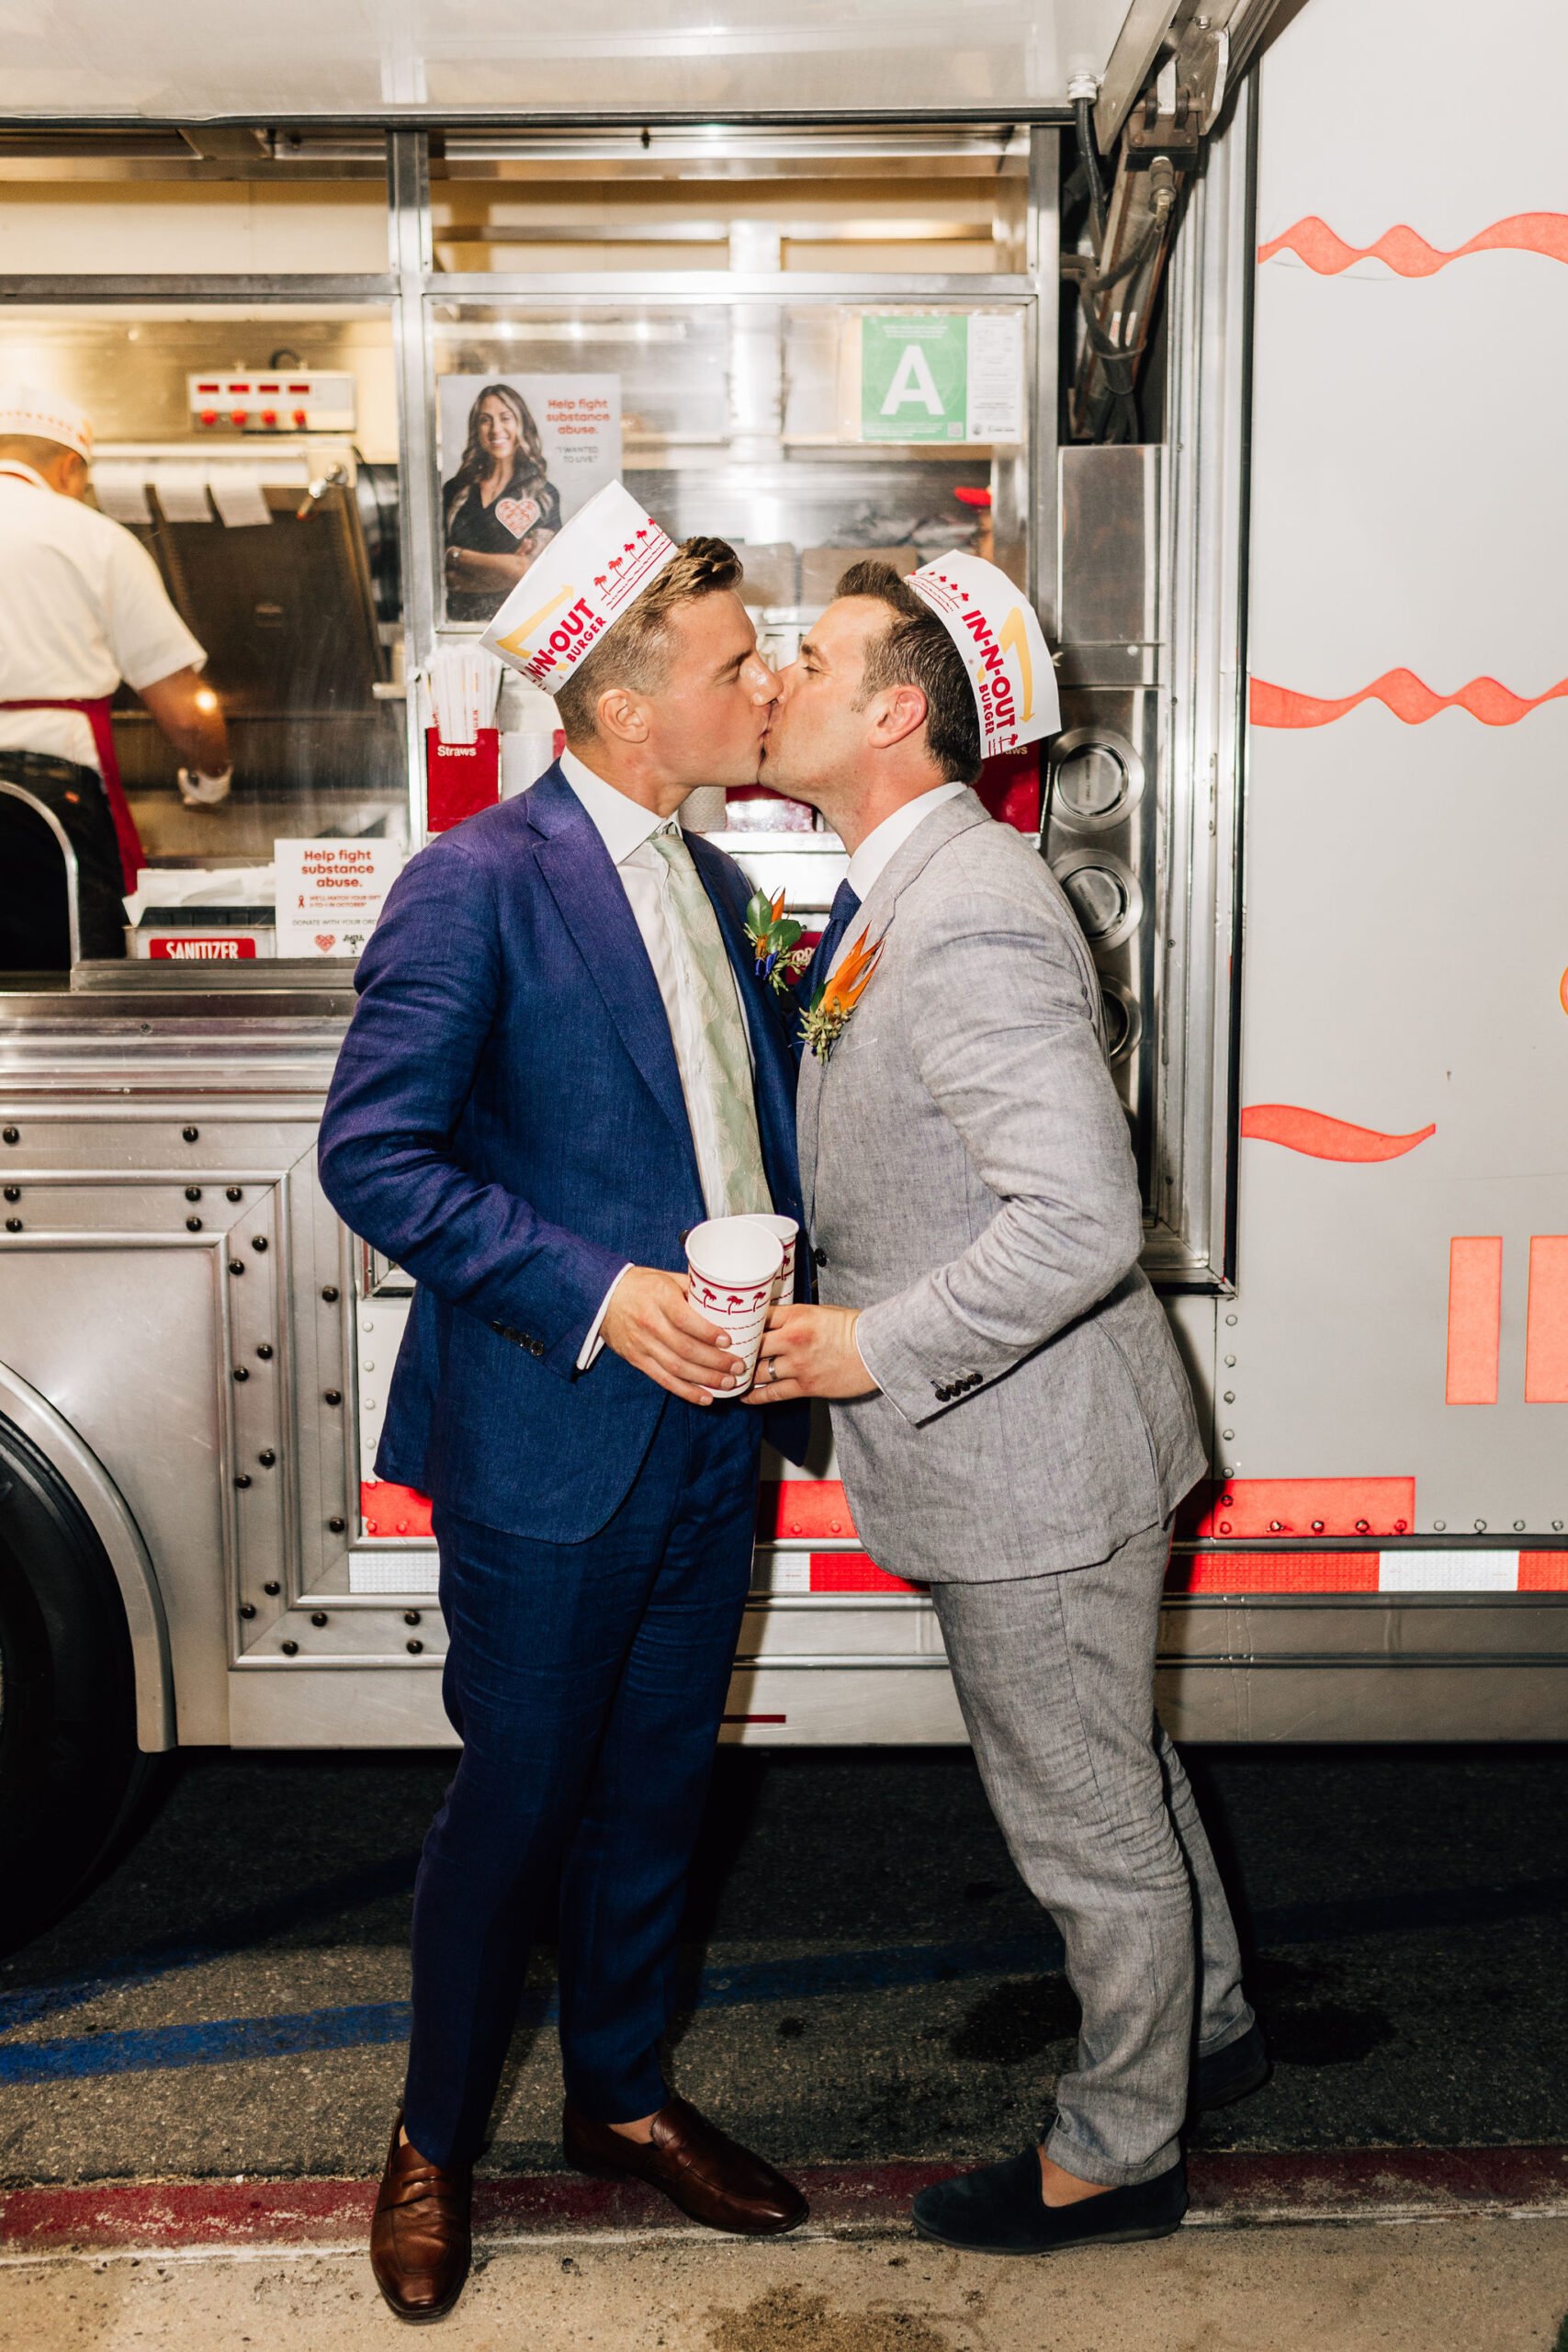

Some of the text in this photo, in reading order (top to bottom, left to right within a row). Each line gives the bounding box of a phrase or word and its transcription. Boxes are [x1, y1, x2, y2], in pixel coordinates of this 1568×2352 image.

[880, 345, 946, 415] A
[547, 399, 608, 411] Help fight
[547, 413, 610, 422] substance
[558, 425, 599, 435] abuse.
[566, 616, 606, 663] BURGER
[961, 609, 1016, 729] IN-N-OUT
[978, 684, 995, 736] BURGER
[437, 746, 478, 757] Straws
[304, 849, 371, 863] Help fight
[301, 865, 375, 875] substance
[316, 877, 363, 888] abuse.
[165, 942, 238, 959] SANITIZER
